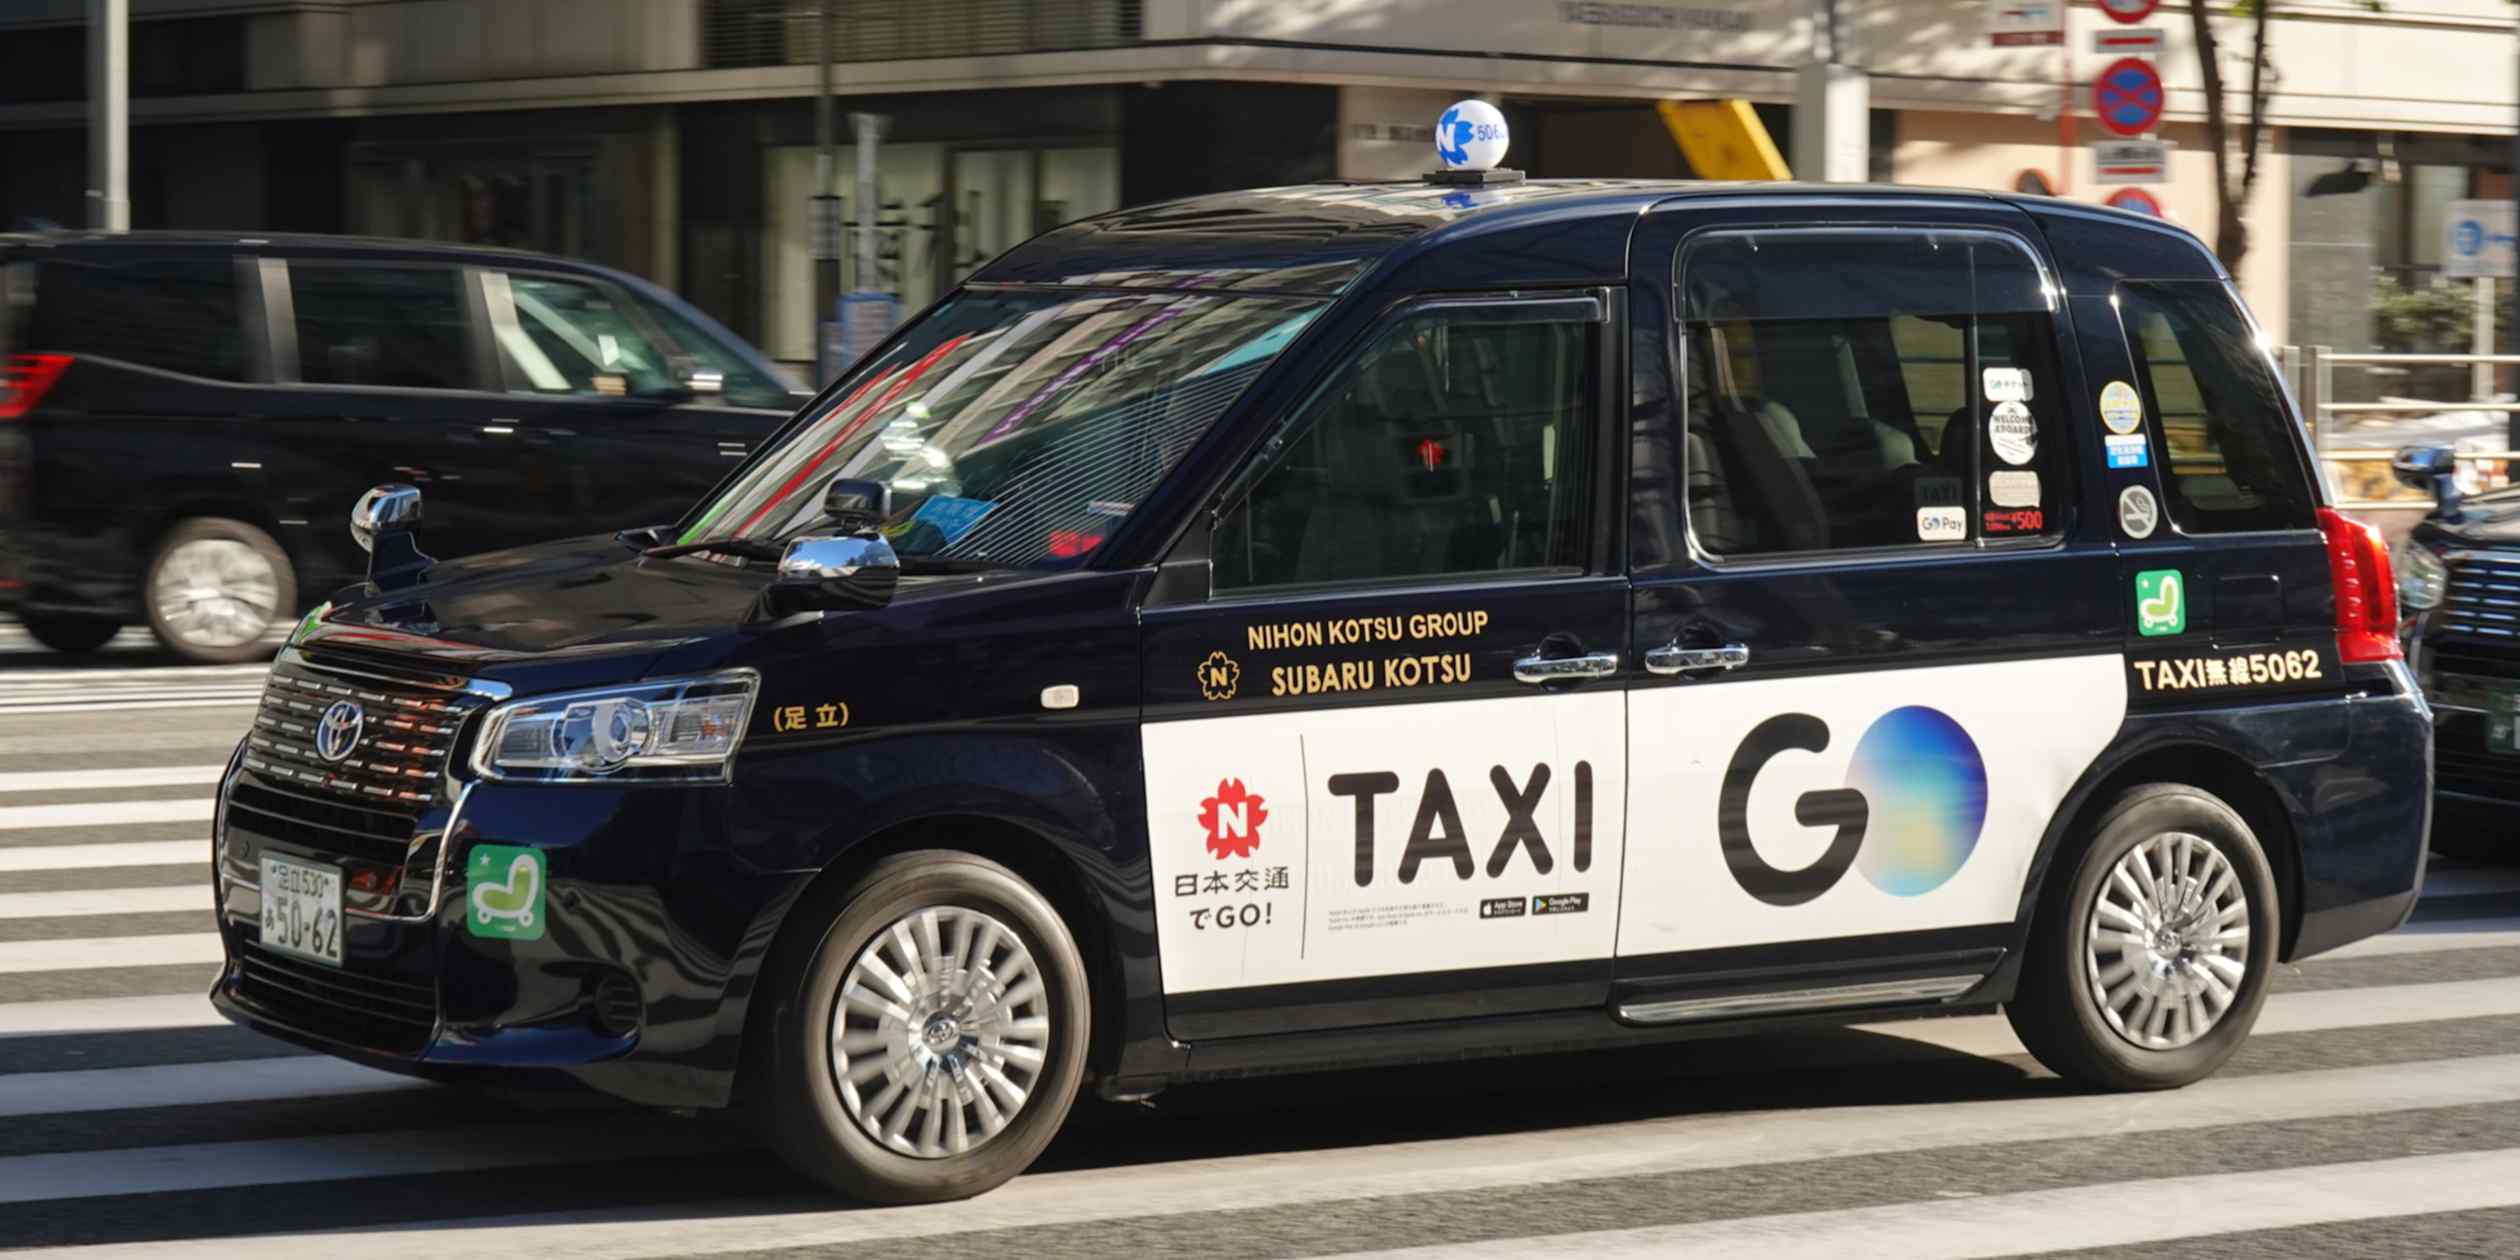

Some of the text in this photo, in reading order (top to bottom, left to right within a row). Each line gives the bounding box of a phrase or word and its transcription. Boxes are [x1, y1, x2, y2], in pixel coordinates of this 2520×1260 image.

[1943, 516, 1962, 532] Pay
[1247, 610, 1488, 650] NIHON KOTSU GROUP
[1210, 666, 1228, 688] N
[1271, 653, 1472, 697] SUBARU KOTSU
[2133, 649, 2322, 690] TAXI無線5062
[1217, 801, 1249, 840] N
[1328, 759, 1594, 888] TAXI
[1718, 704, 1988, 907] GO
[1174, 866, 1290, 897] 日本交通
[1189, 902, 1272, 930] でGO!
[1548, 897, 1570, 908] Google
